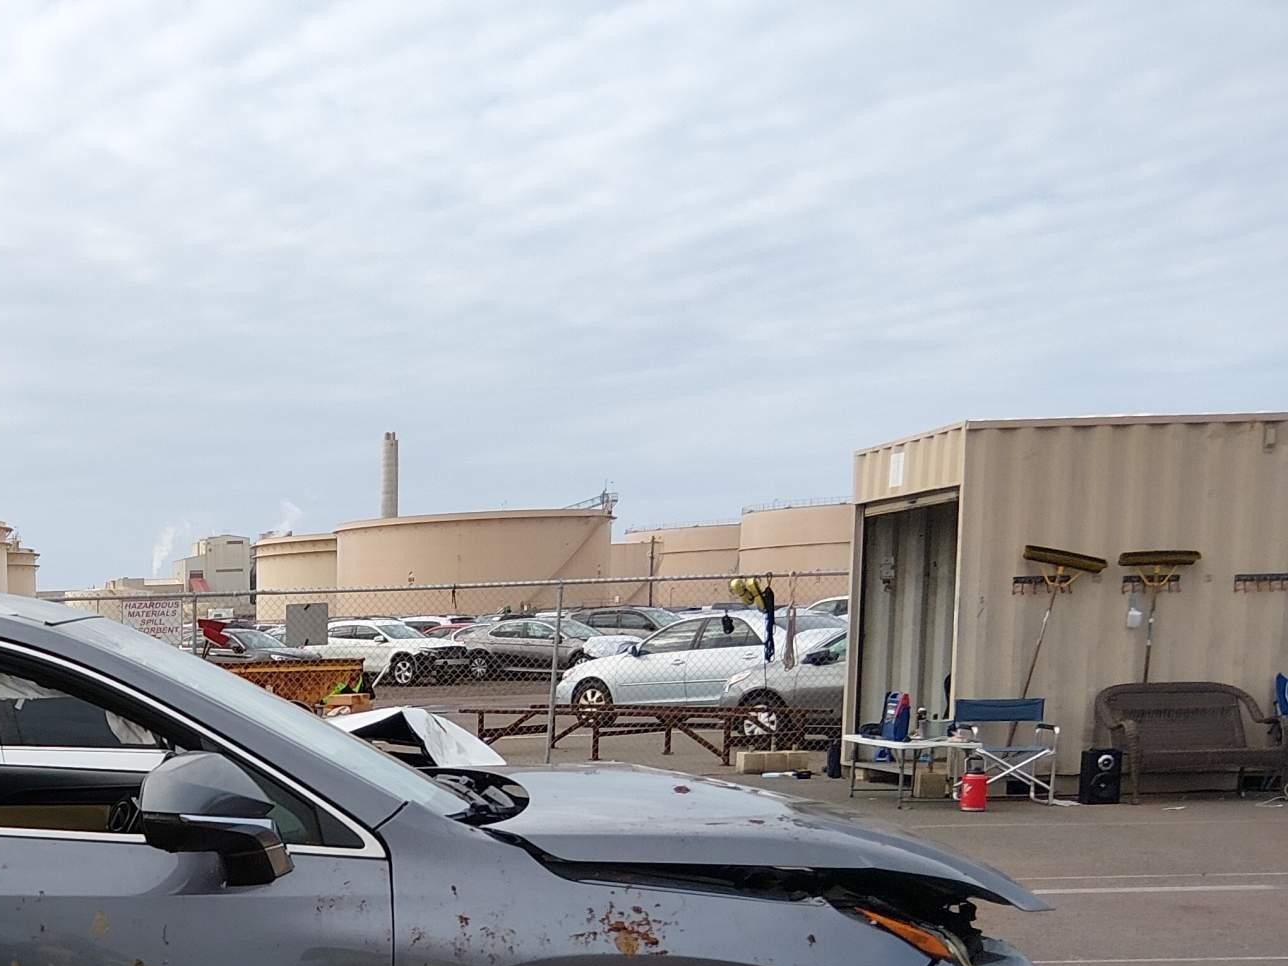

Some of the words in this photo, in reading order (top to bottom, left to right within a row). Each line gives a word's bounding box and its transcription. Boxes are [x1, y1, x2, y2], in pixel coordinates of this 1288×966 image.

[124, 601, 179, 609] HAZARDOUS
[127, 609, 177, 617] MATERIALS
[140, 618, 165, 626] SPILL
